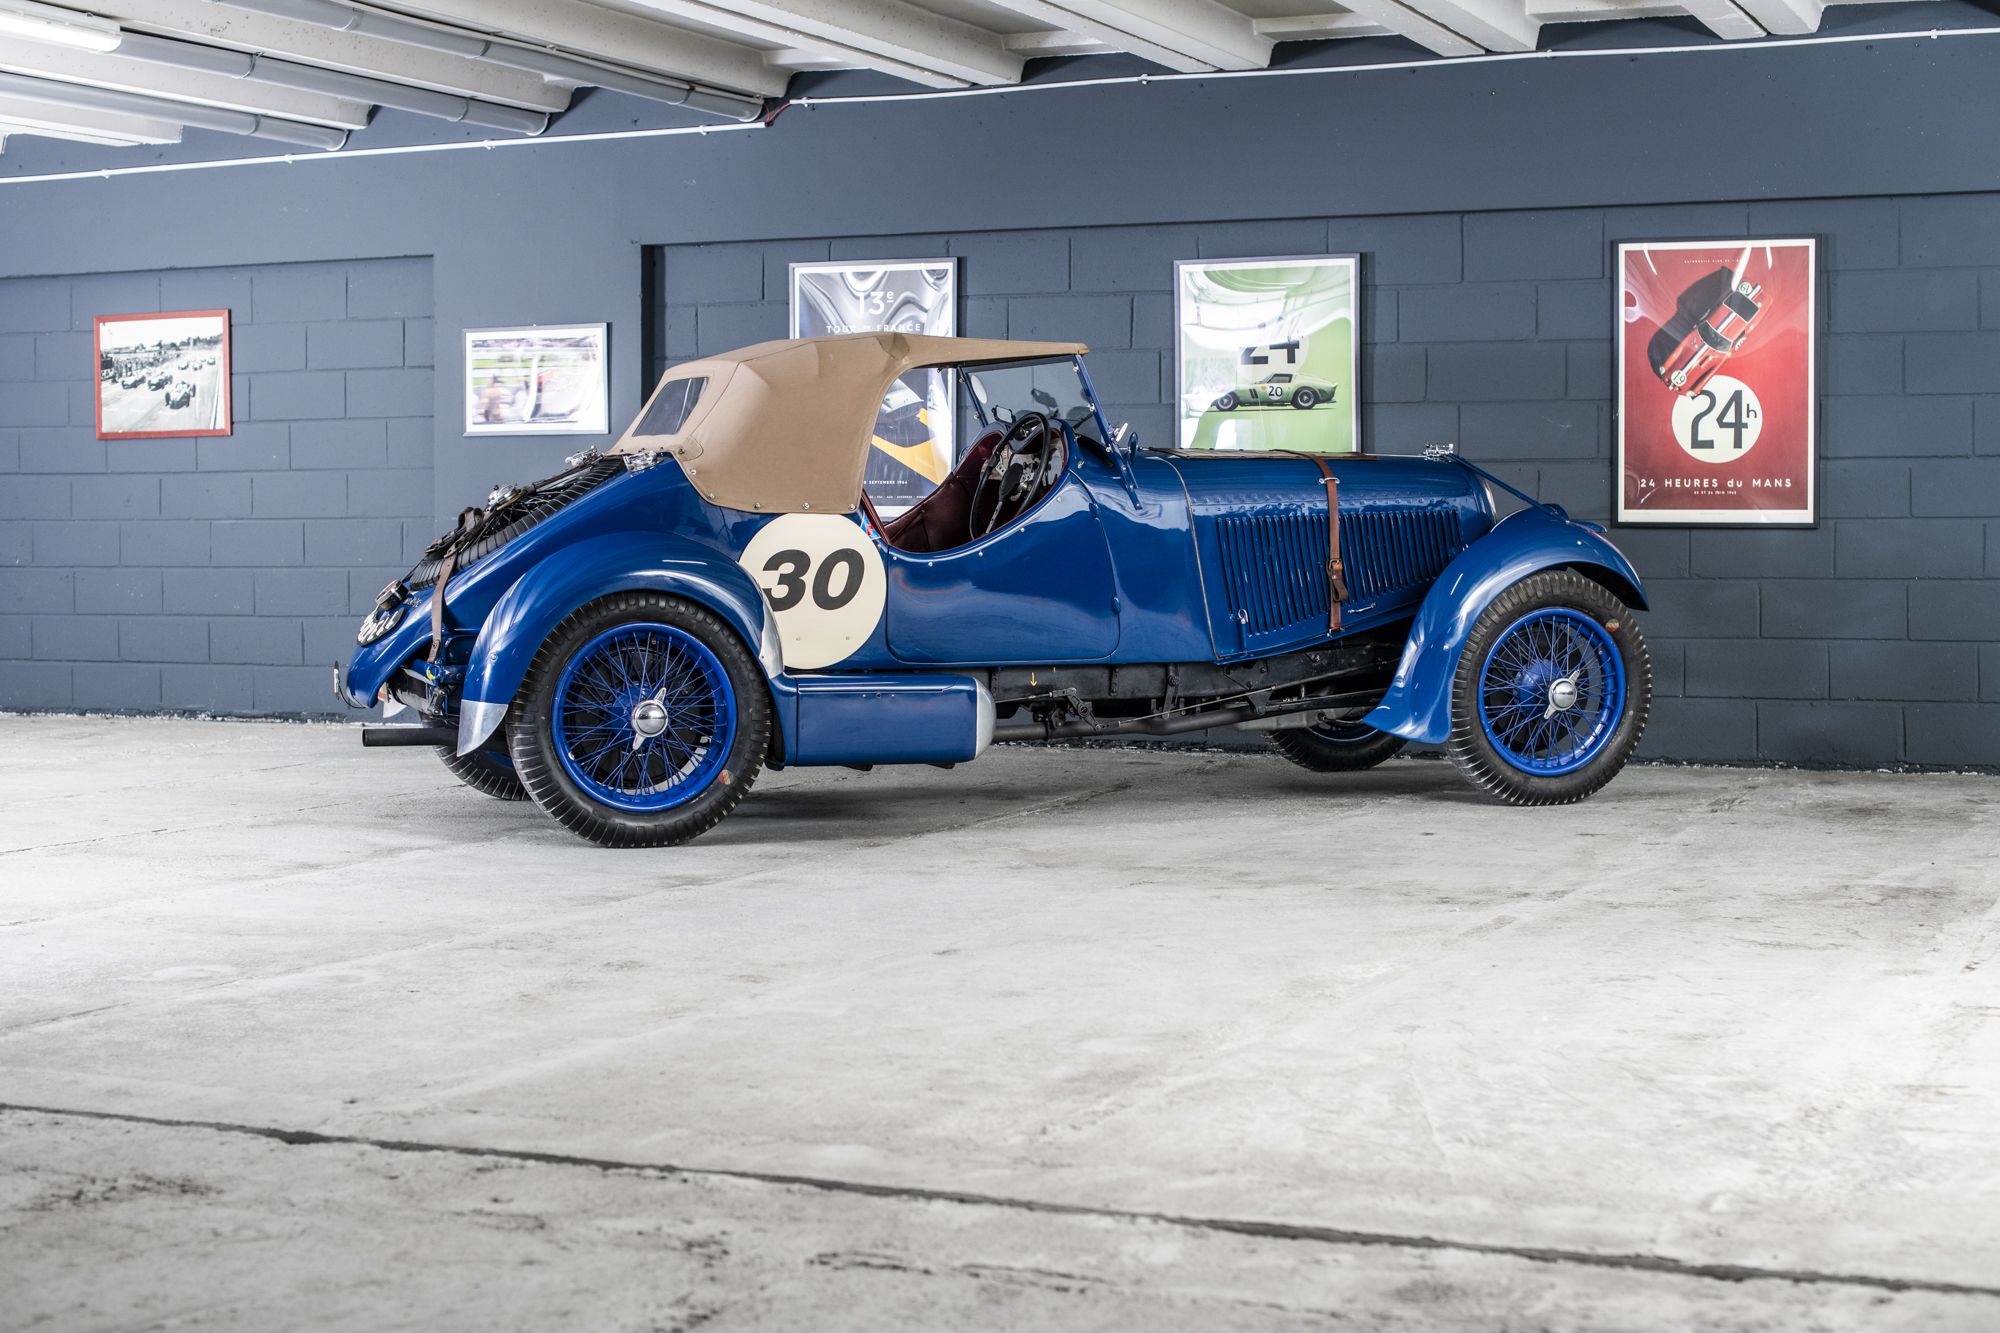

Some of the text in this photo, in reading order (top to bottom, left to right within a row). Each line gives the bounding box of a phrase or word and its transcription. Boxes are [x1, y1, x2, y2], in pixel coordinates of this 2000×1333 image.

[877, 323, 921, 332] FRANCE
[1268, 385, 1283, 397] 20
[1640, 478, 1792, 488] 24 HEURES du MANS
[762, 548, 865, 612] 30
